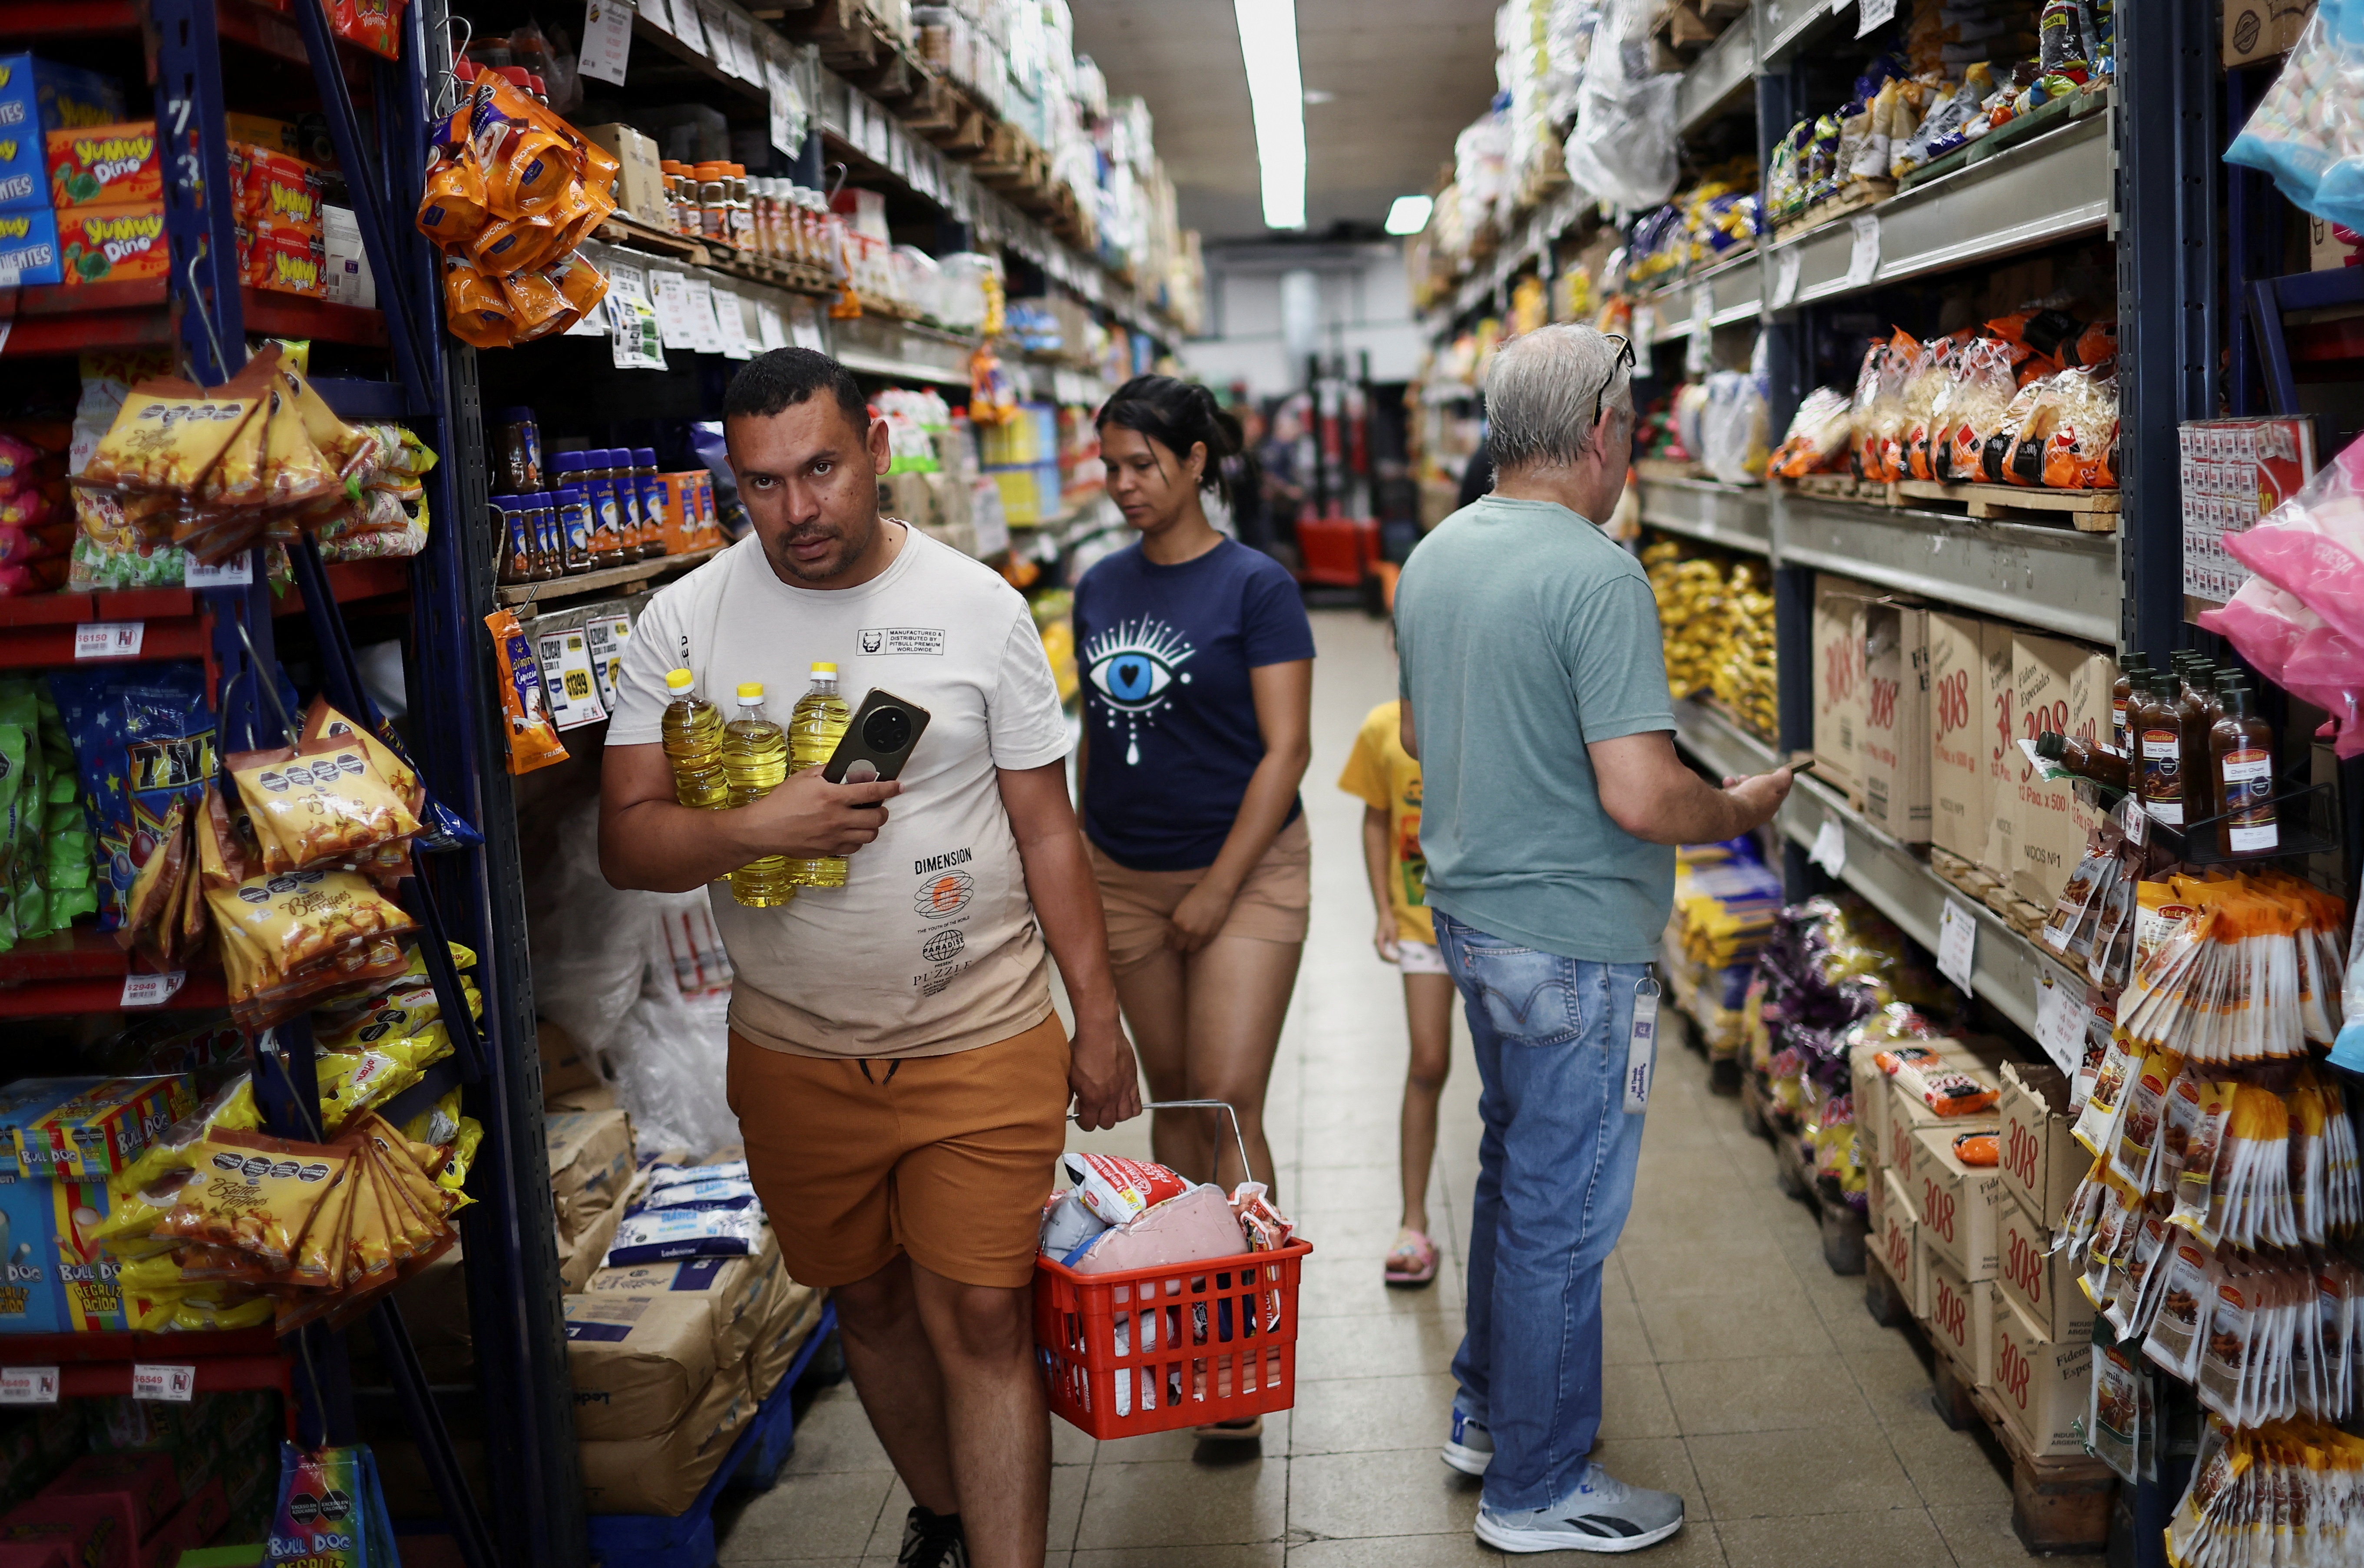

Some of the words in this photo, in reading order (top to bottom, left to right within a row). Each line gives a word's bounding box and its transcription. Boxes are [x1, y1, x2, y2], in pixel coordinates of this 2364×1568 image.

[94, 158, 140, 183] Dino
[506, 142, 541, 187] TRADICIONAL
[104, 237, 151, 262] Dino
[2313, 542, 2356, 575] FRESA
[78, 634, 107, 642] $6150
[566, 673, 588, 697] $1399
[2019, 664, 2037, 689] Fideos
[2020, 673, 2051, 707] Especiales
[1868, 676, 1898, 730] 308
[1936, 668, 1968, 743] 308
[1994, 688, 2013, 760] 30
[2019, 784, 2027, 801] 12
[2051, 794, 2066, 812] 500
[915, 847, 972, 875] DIMENSION
[2024, 844, 2047, 864] NIDOS
[957, 915, 970, 924] WORLD
[922, 937, 964, 954] PARADISE
[913, 960, 972, 986] PUZZLE
[934, 960, 953, 968] PRESENT
[2090, 1020, 2103, 1030] POLVO
[116, 1130, 145, 1158] BULL
[143, 1111, 170, 1142] DOG
[21, 1150, 48, 1165] BULL
[50, 1149, 77, 1165] DOG
[2004, 1117, 2038, 1190] 308
[208, 1178, 261, 1197] Butter
[1980, 1177, 1999, 1194] Fide
[221, 1195, 269, 1210] Toffees
[1922, 1177, 1954, 1243] 308
[6, 1263, 43, 1284] DOG
[57, 1262, 96, 1284] BULL
[98, 1261, 122, 1281] DO
[2004, 1228, 2042, 1303] 308
[74, 1284, 123, 1301] REGALIZ
[1934, 1277, 1966, 1347] 308
[2056, 1346, 2090, 1367] Fideos
[134, 1375, 162, 1384] $6549
[1997, 1332, 2030, 1410] 308
[2105, 1369, 2123, 1386] omillo
[270, 1537, 308, 1558] BULL
[312, 1532, 352, 1554] DOG
